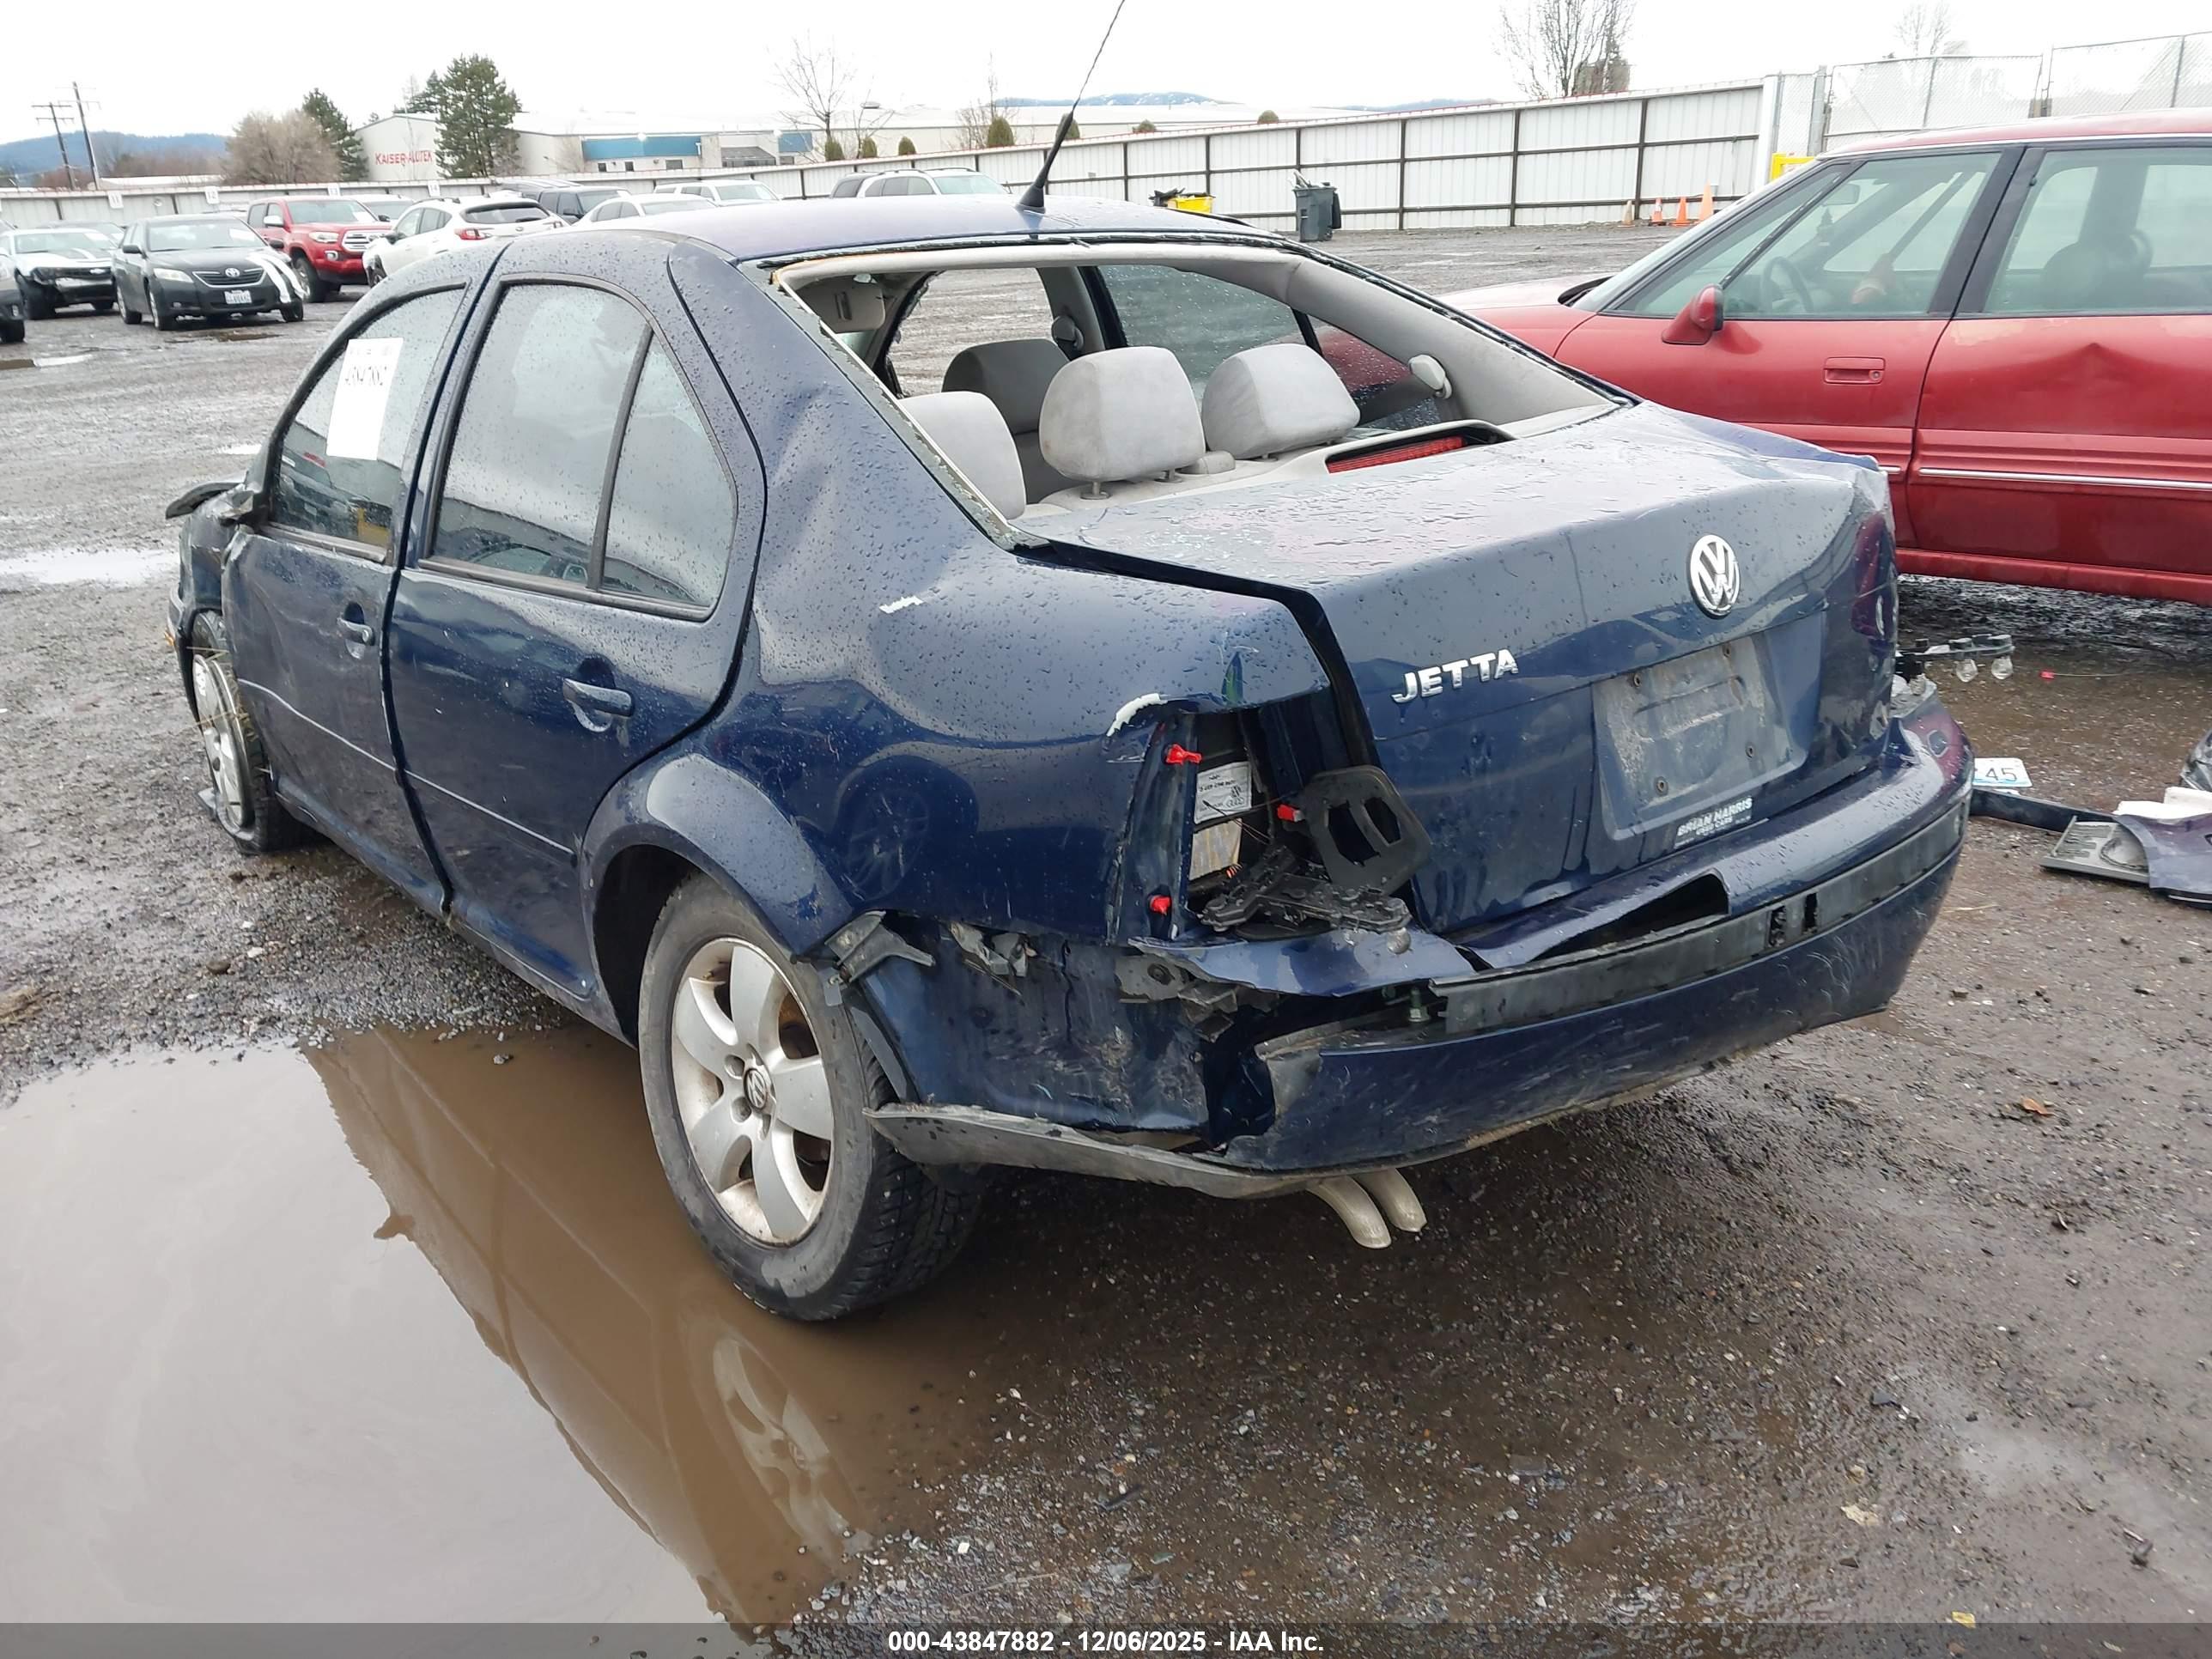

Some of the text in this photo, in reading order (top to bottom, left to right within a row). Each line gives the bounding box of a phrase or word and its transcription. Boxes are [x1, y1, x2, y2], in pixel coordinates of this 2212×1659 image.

[1391, 648, 1519, 703] JETTA
[1677, 812, 1712, 837] BRIAN
[1714, 797, 1753, 822] HARRIS
